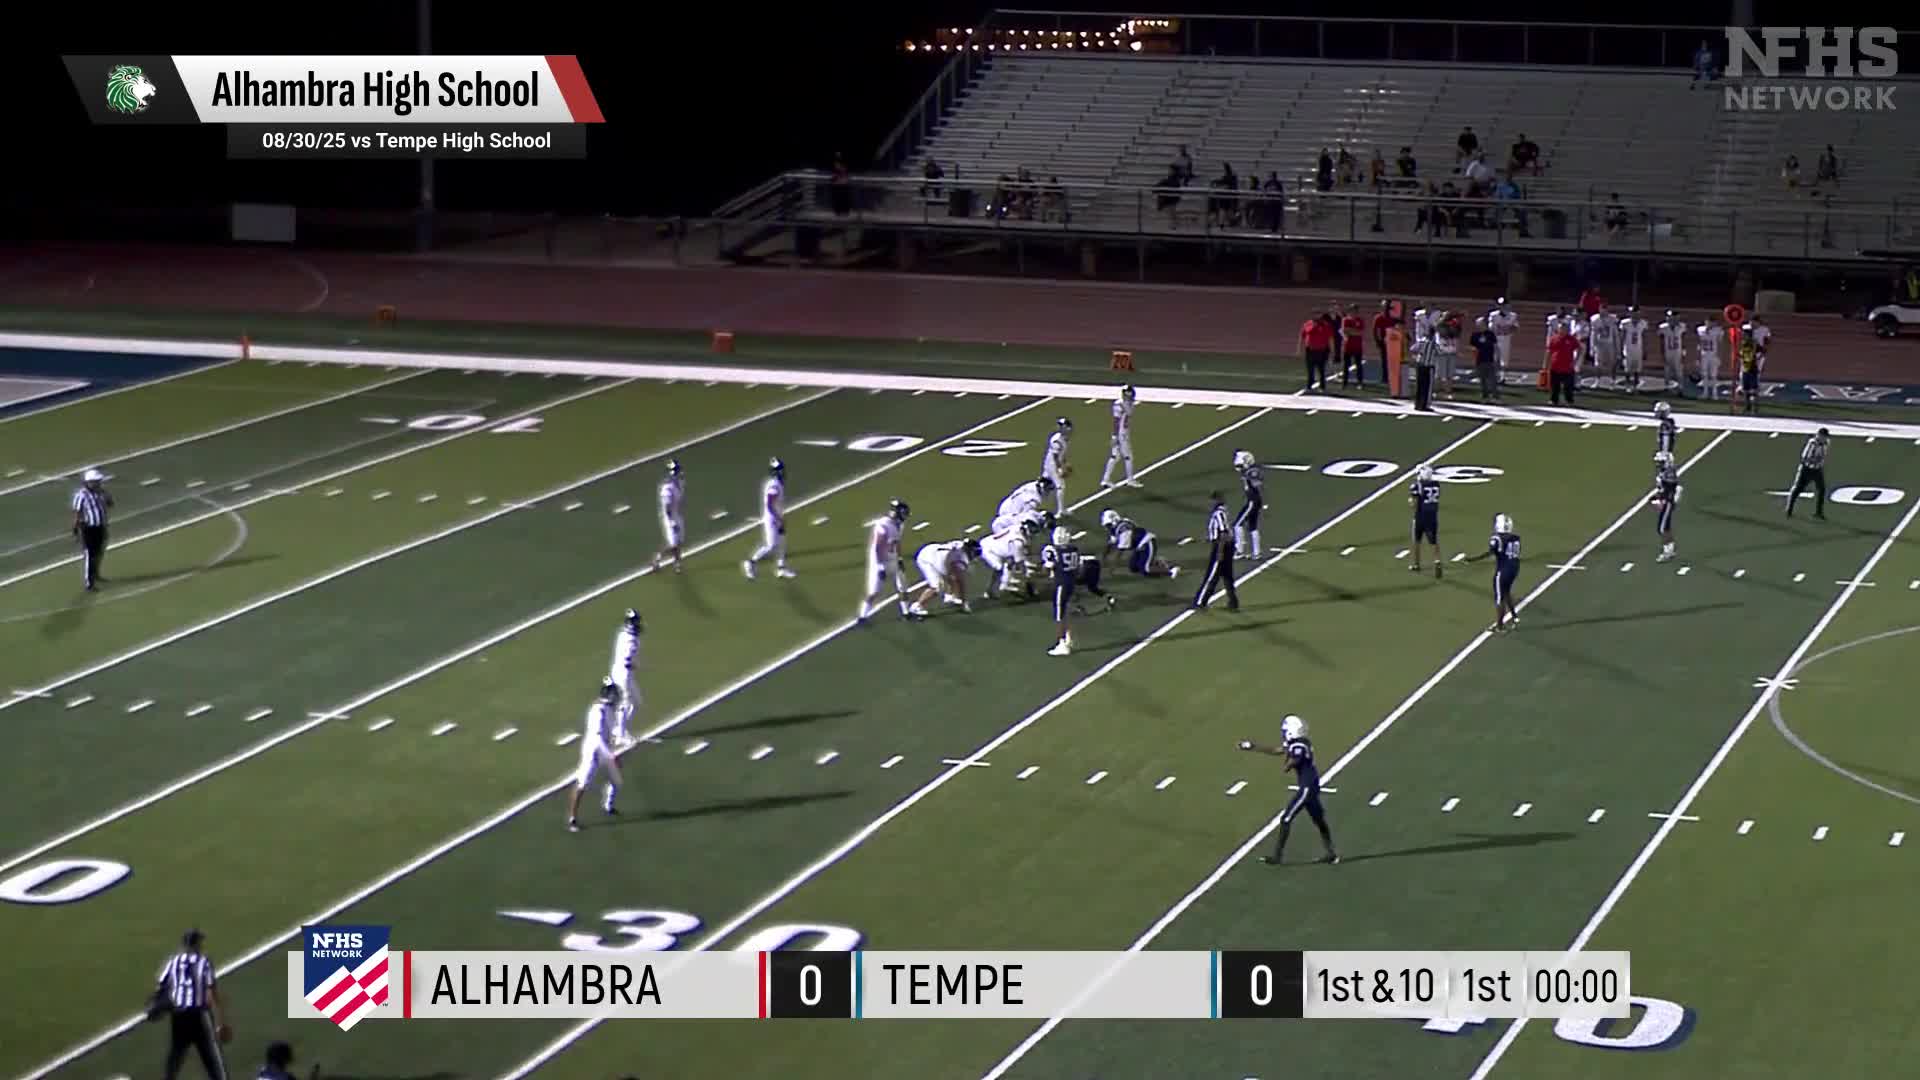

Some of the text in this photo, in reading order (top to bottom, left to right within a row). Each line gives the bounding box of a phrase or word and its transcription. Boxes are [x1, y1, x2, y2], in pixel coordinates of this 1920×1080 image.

[847, 435, 1028, 457] 20
[1424, 487, 1440, 503] 32
[1062, 552, 1078, 571] 50
